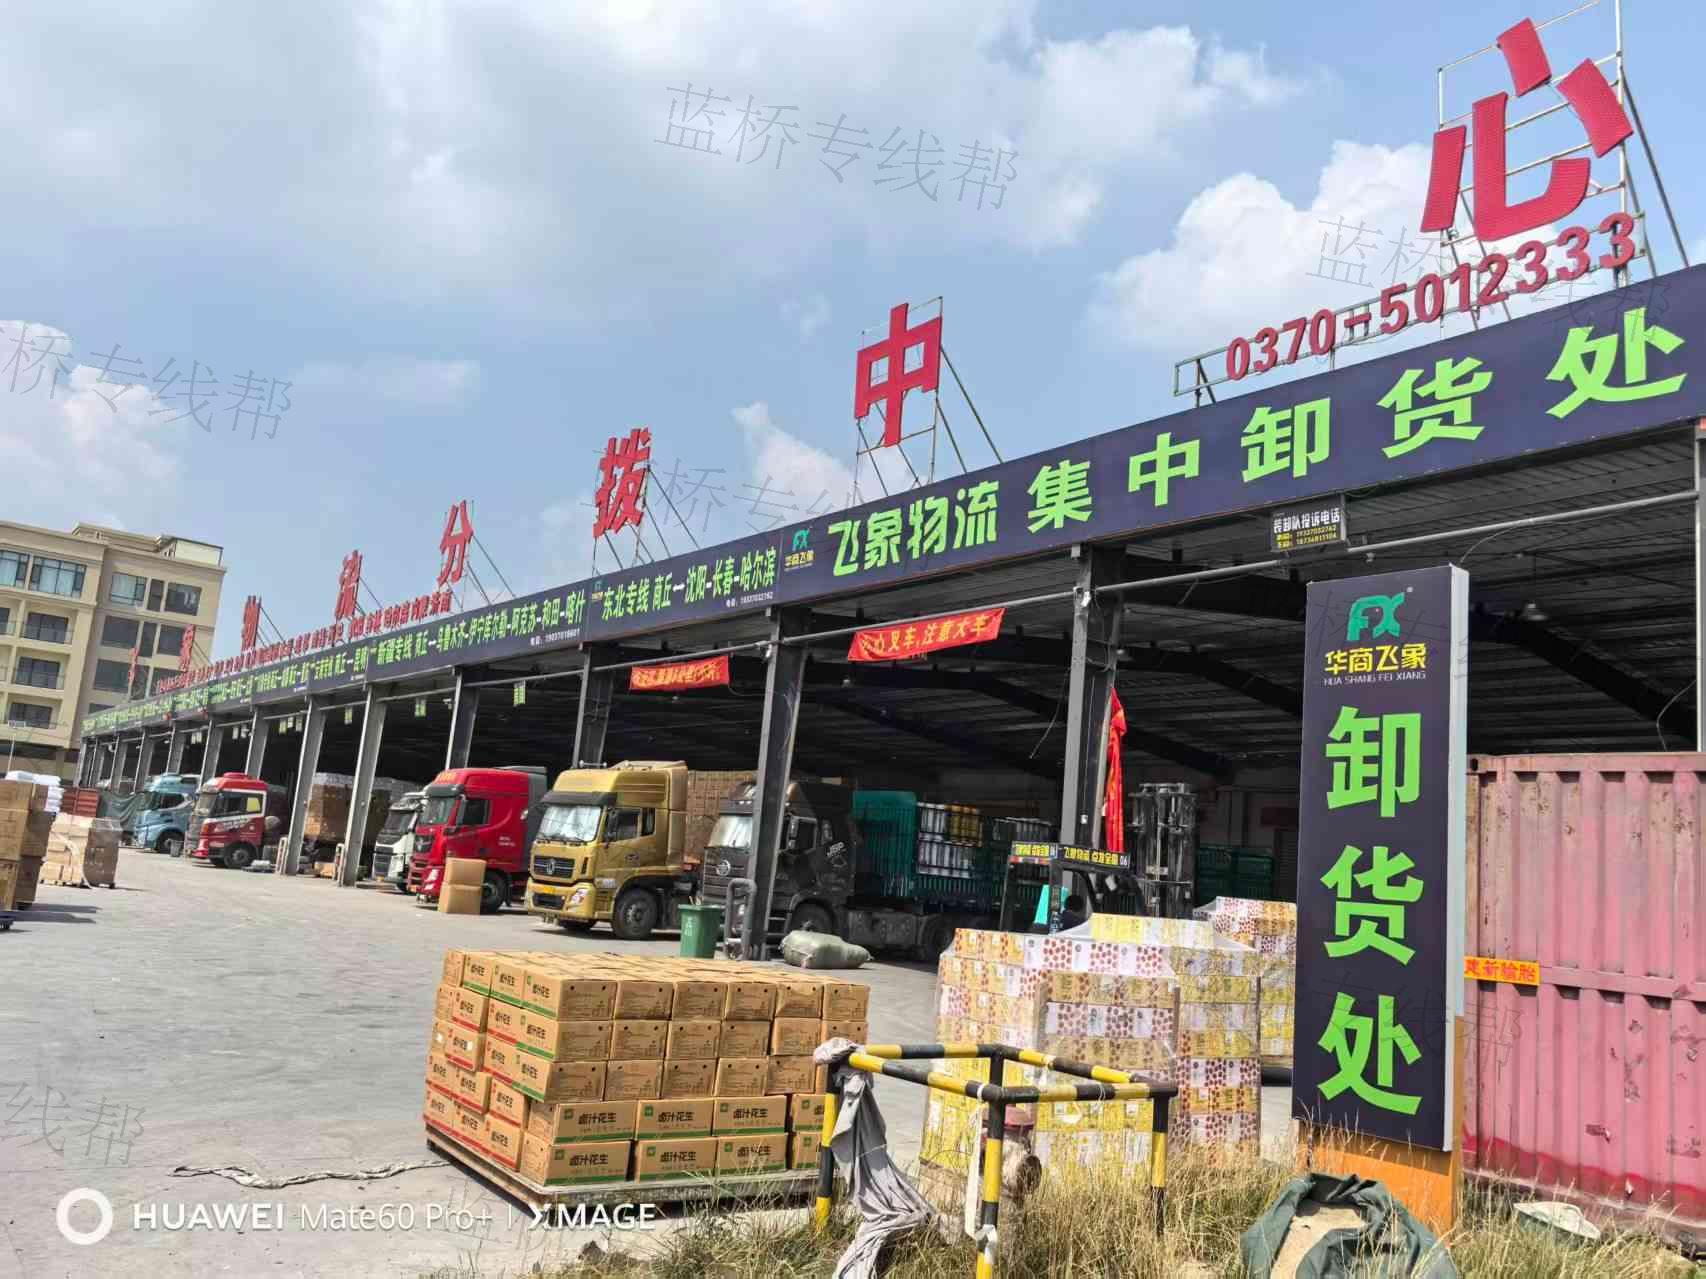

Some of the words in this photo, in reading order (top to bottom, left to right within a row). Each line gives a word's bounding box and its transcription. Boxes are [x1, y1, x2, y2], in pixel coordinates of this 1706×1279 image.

[437, 500, 474, 586] 分
[593, 427, 650, 539] 拨
[854, 303, 942, 447] 中
[1420, 17, 1634, 242] 心
[1226, 212, 1635, 381] 0370-5012333
[828, 480, 998, 577] 飞象物流
[1324, 642, 1427, 675] 华商飞象
[1324, 677, 1344, 687] HUA
[1378, 672, 1393, 682] FEI
[1396, 670, 1426, 681] XIANG
[1316, 705, 1425, 1116] 卸货处
[577, 1112, 617, 1125] 卤汁花生
[657, 1111, 695, 1123] 卤汁花生
[733, 1107, 769, 1119] 卤汁花生
[569, 1152, 609, 1167] 卤汁花生
[660, 1150, 697, 1163] 卤汁花生
